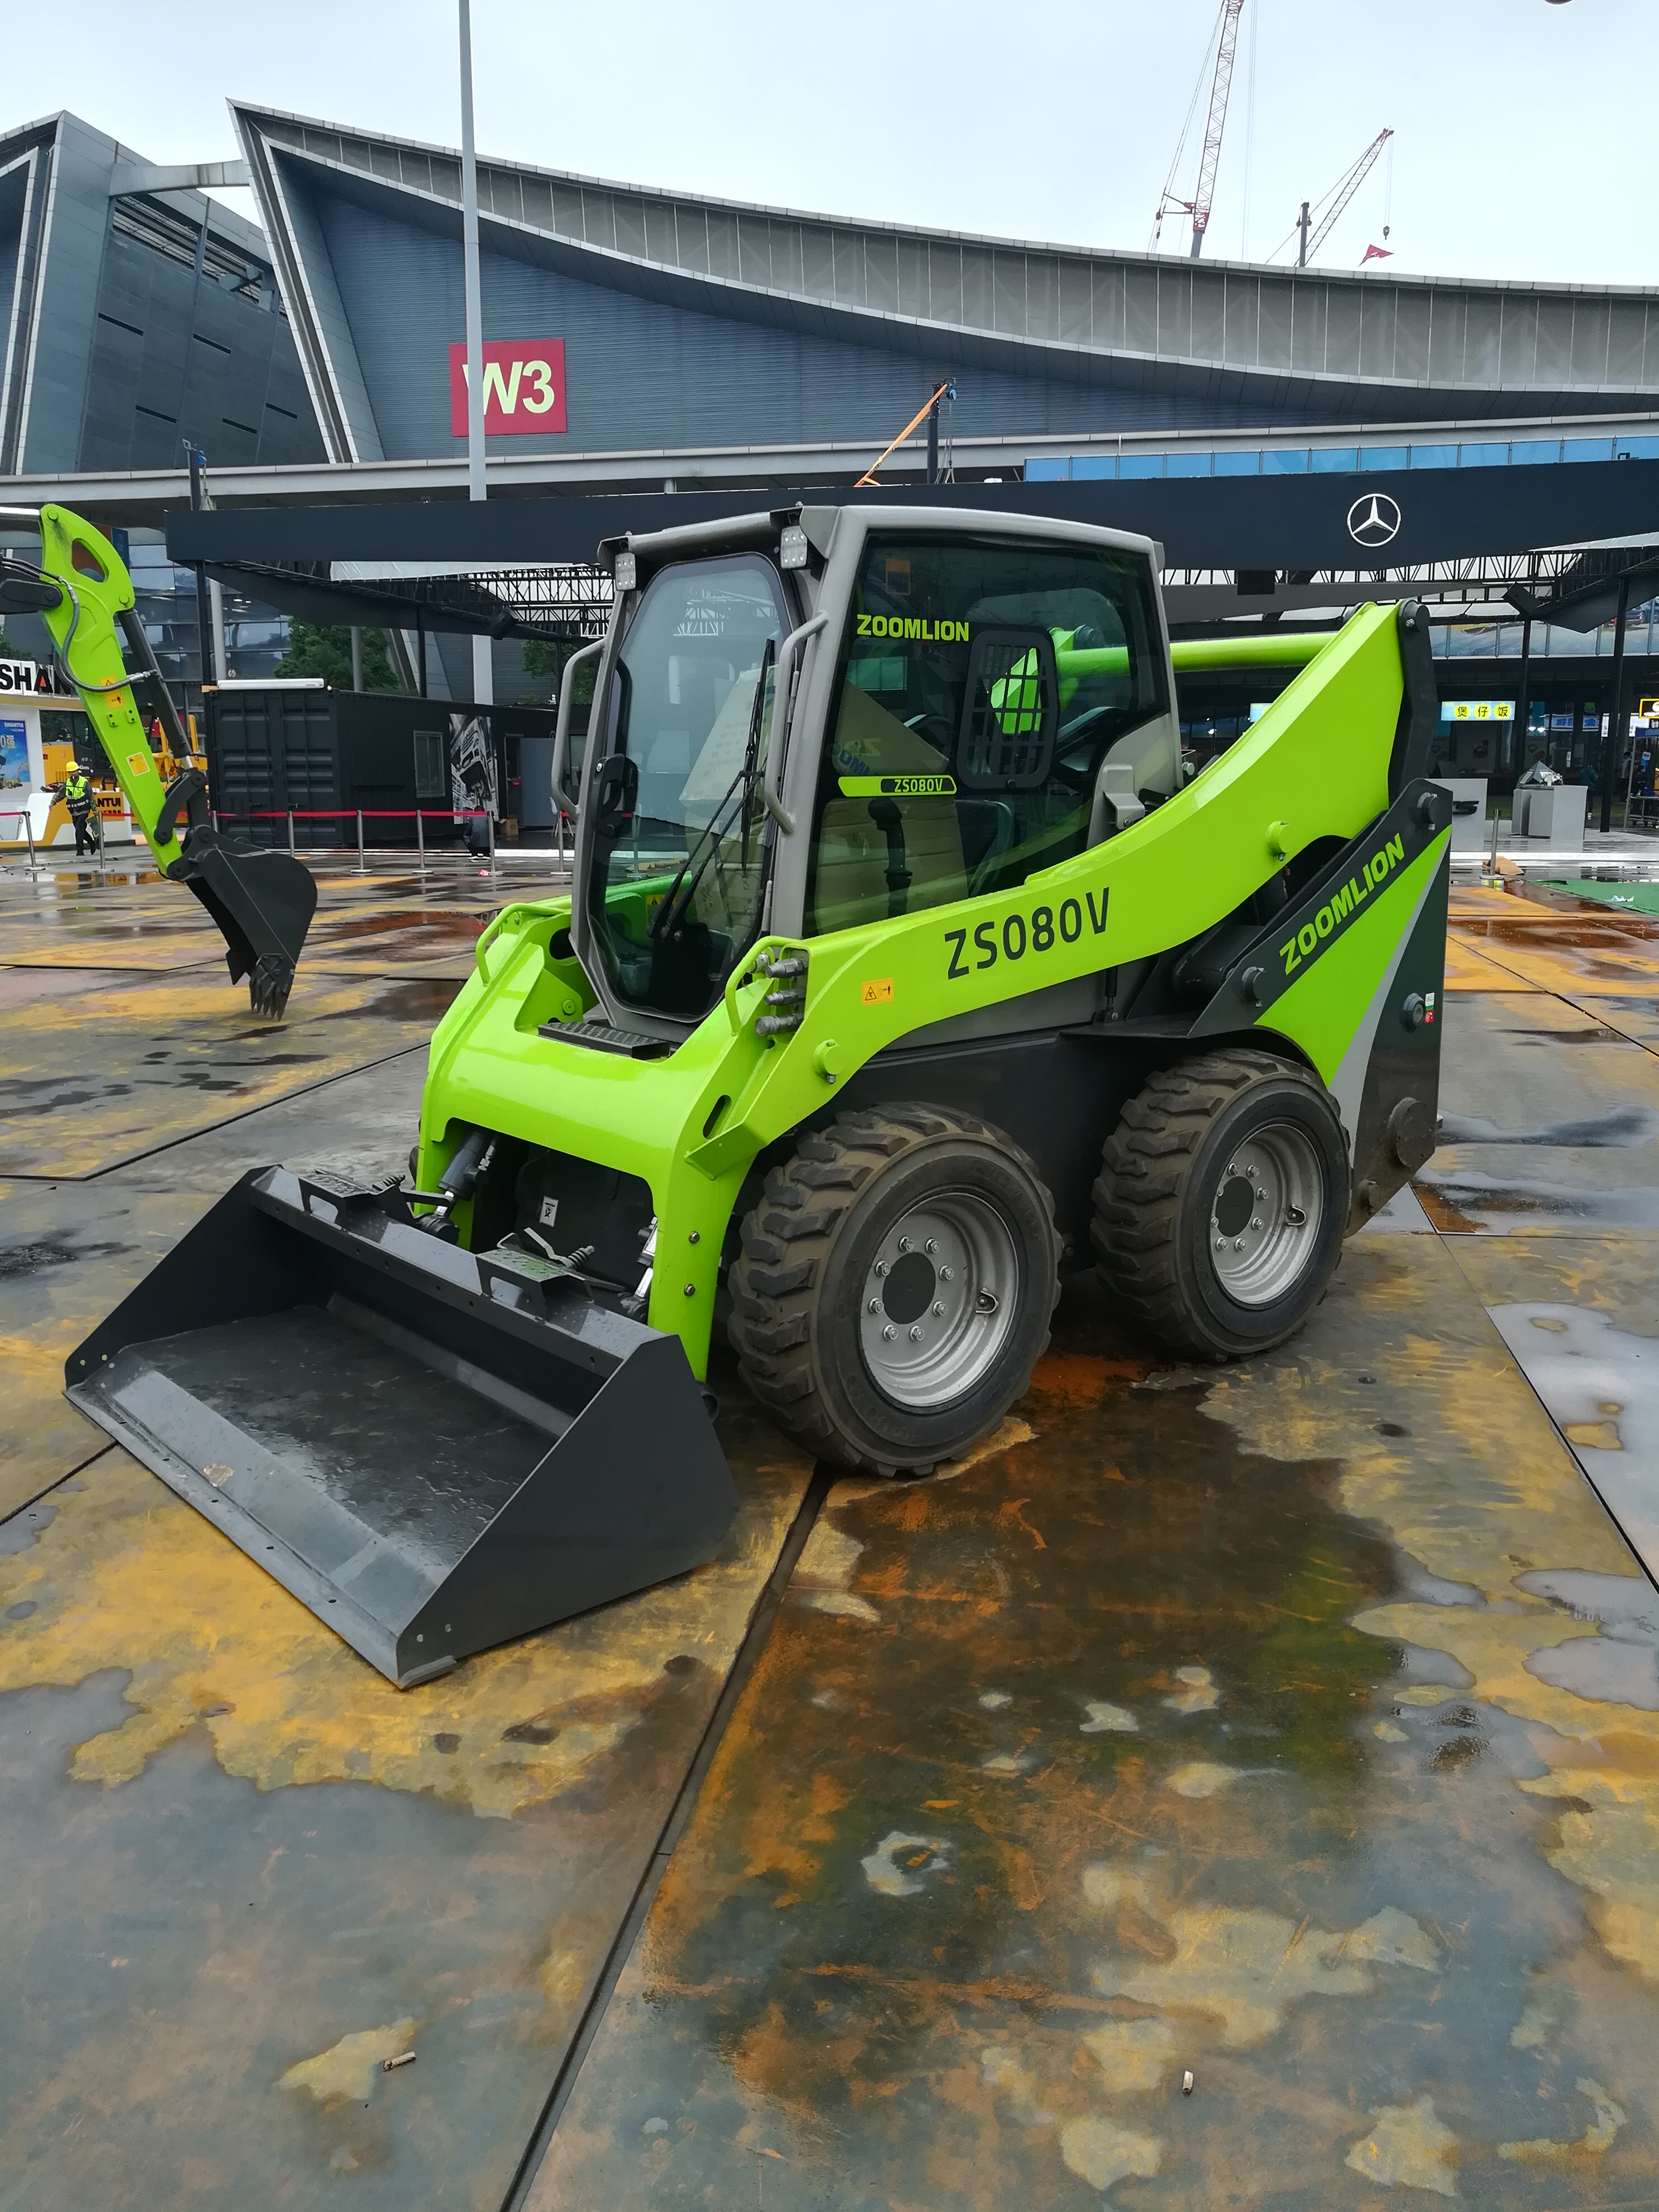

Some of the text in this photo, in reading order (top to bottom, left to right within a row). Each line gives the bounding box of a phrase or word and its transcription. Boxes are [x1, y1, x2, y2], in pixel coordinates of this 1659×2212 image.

[462, 360, 555, 415] W3
[857, 614, 969, 641] ZOOMLION
[1457, 706, 1508, 717] 煲仔饭
[894, 779, 943, 793] ZS080V
[1279, 833, 1405, 976] ZOOMLION
[944, 886, 1109, 980] ZS080V
